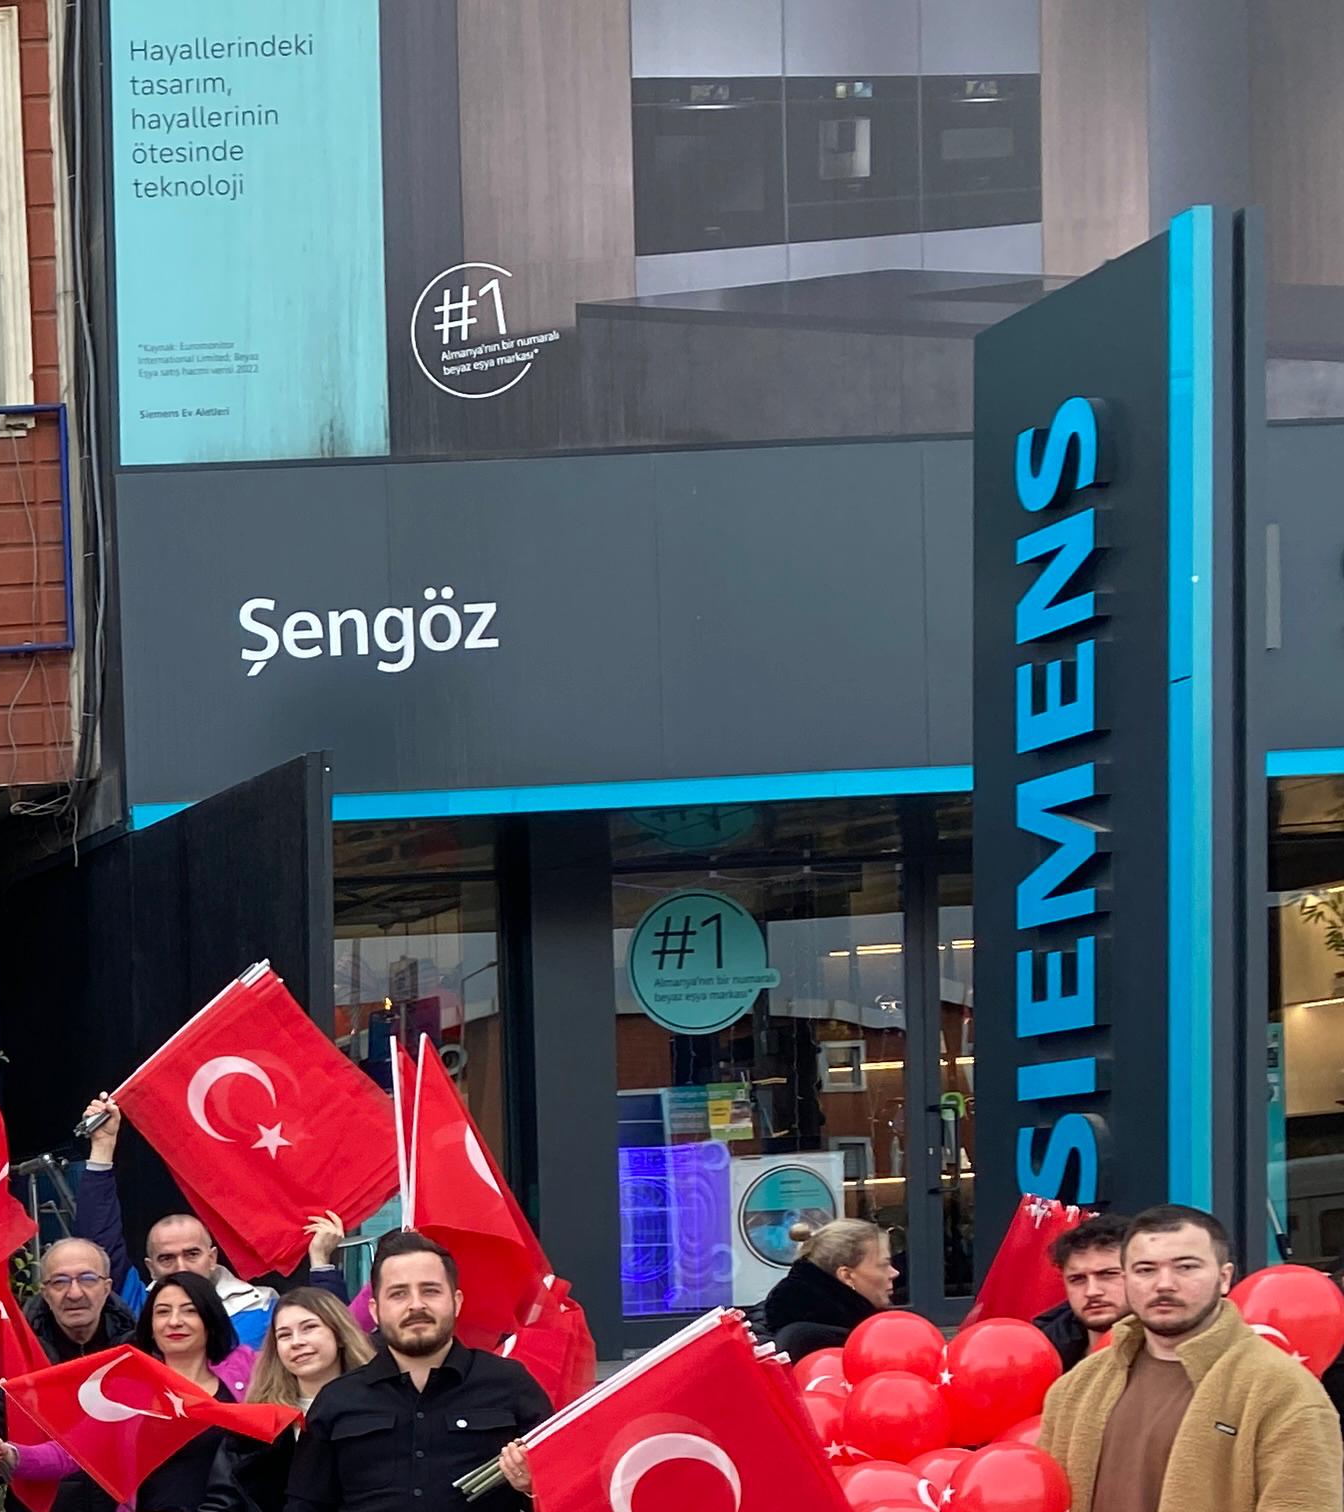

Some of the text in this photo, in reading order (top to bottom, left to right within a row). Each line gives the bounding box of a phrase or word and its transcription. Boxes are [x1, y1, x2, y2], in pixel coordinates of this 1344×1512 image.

[129, 33, 314, 66] Hayallerindeki
[129, 75, 232, 97] tasarım,
[130, 103, 279, 134] hayallerinin
[131, 139, 244, 164] ötesinde
[132, 173, 244, 201] teknoloji
[433, 278, 507, 345] #1
[501, 339, 515, 350] bir
[443, 361, 471, 376] beyaz
[139, 409, 180, 419] Siemens
[239, 586, 500, 677] Şengöz
[1016, 397, 1099, 1205] SIEMENS
[651, 912, 723, 970] #1
